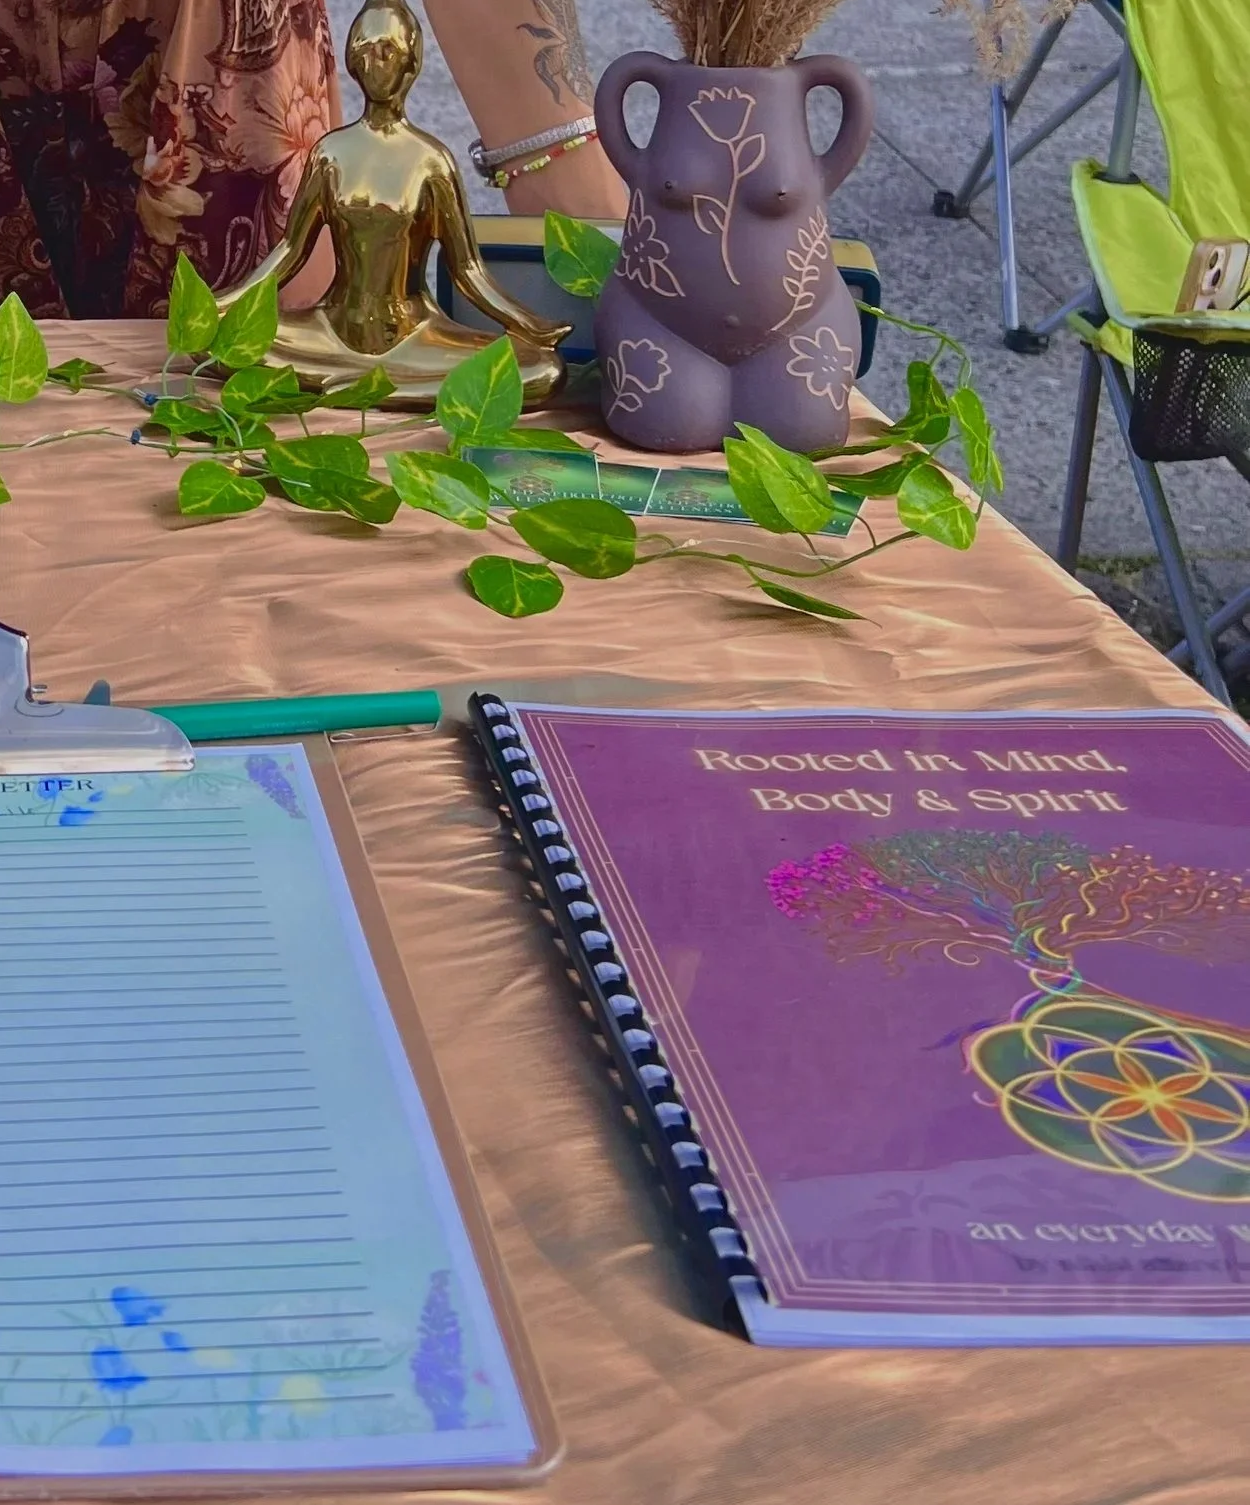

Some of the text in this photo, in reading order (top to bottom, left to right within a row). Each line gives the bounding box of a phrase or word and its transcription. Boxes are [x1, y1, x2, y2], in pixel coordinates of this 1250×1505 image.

[693, 748, 1129, 773] Rooted in Mind,
[750, 787, 1130, 818] Body & Spirit
[966, 1221, 1028, 1241] an
[1034, 1219, 1216, 1248] everyday
